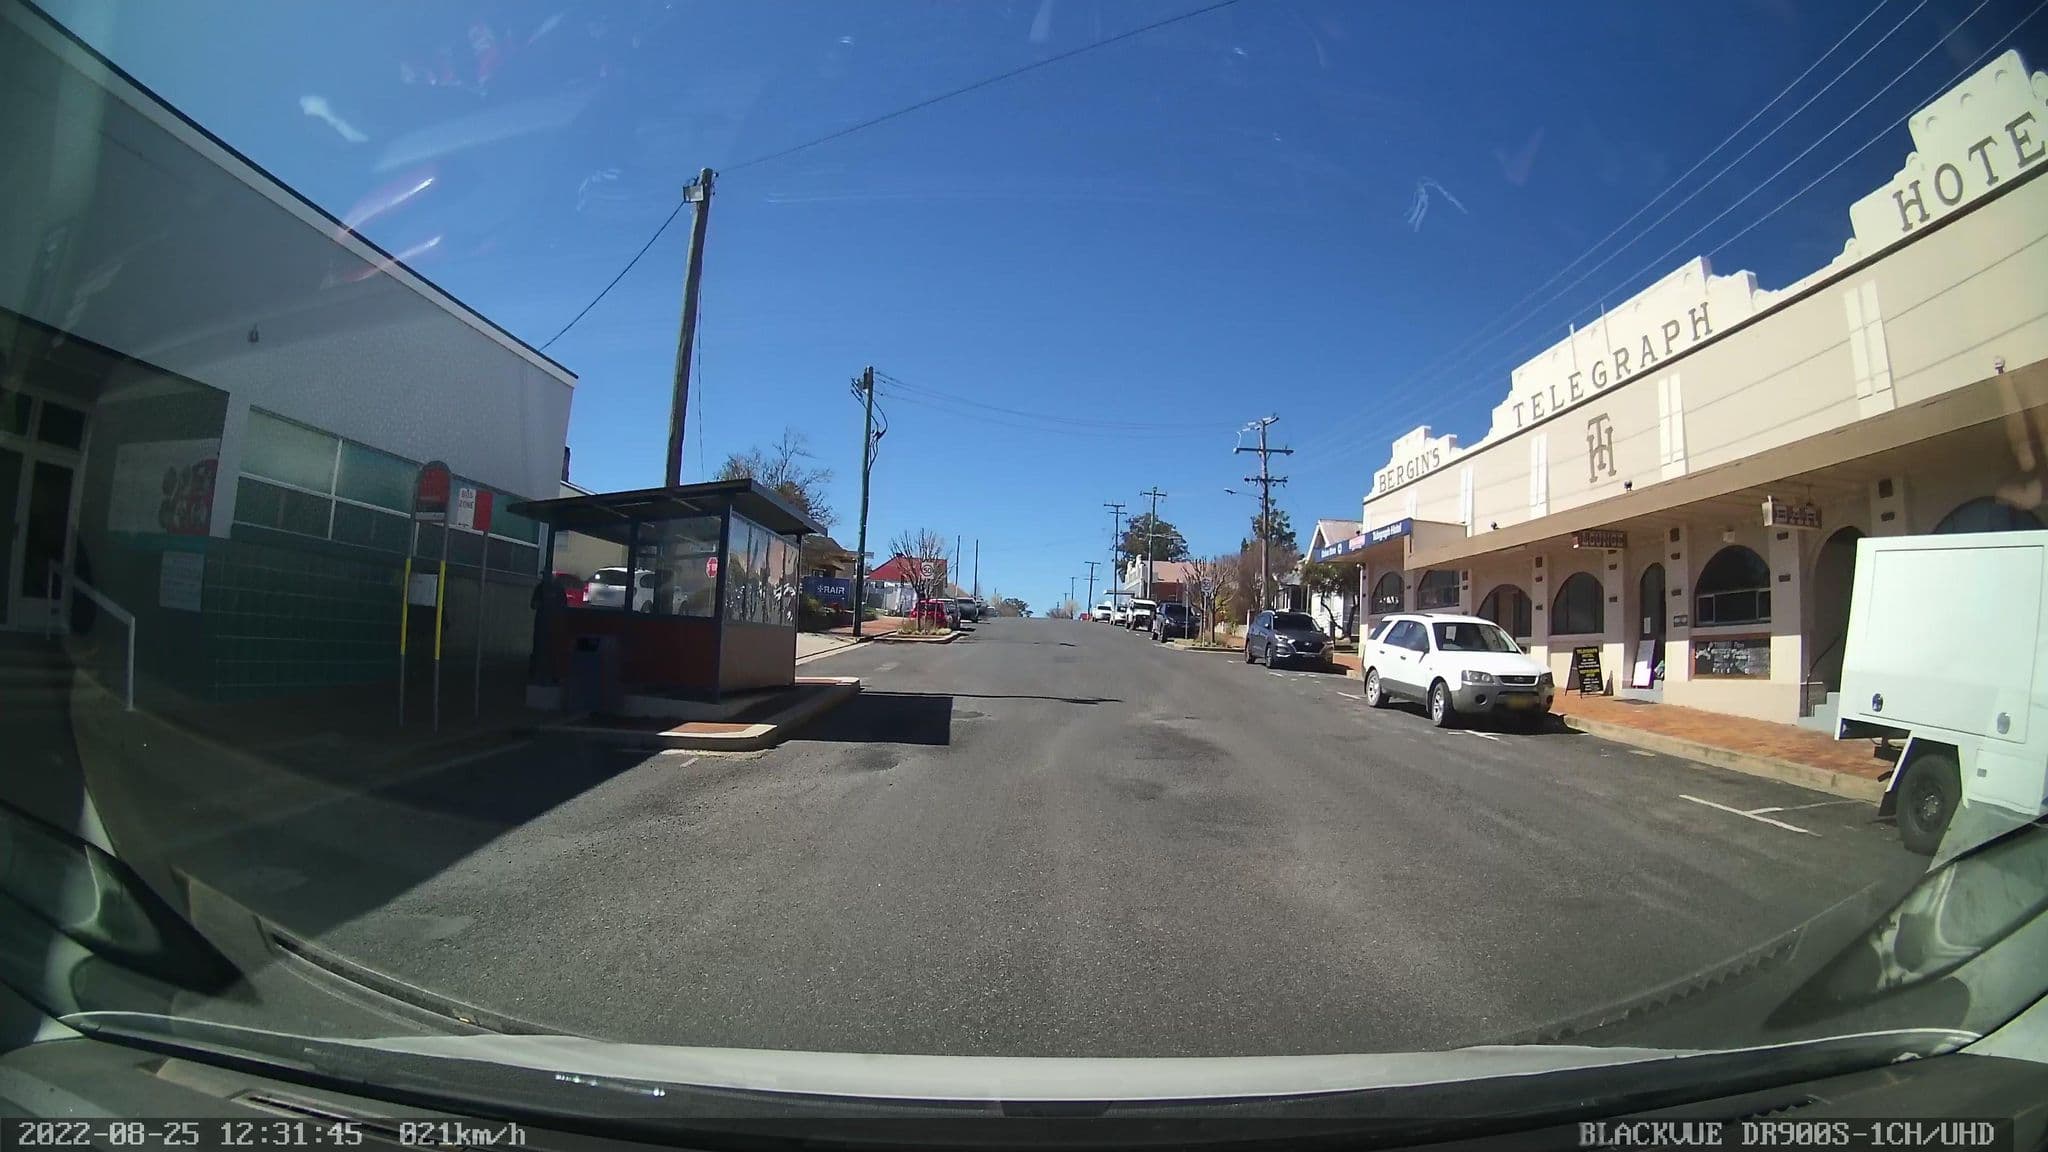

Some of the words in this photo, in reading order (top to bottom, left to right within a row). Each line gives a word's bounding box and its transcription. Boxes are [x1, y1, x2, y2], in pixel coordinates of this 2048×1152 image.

[1378, 447, 1441, 493] BERGIN'S
[1512, 301, 1714, 429] TELEGRAPH
[1580, 532, 1625, 547] LOUNGE
